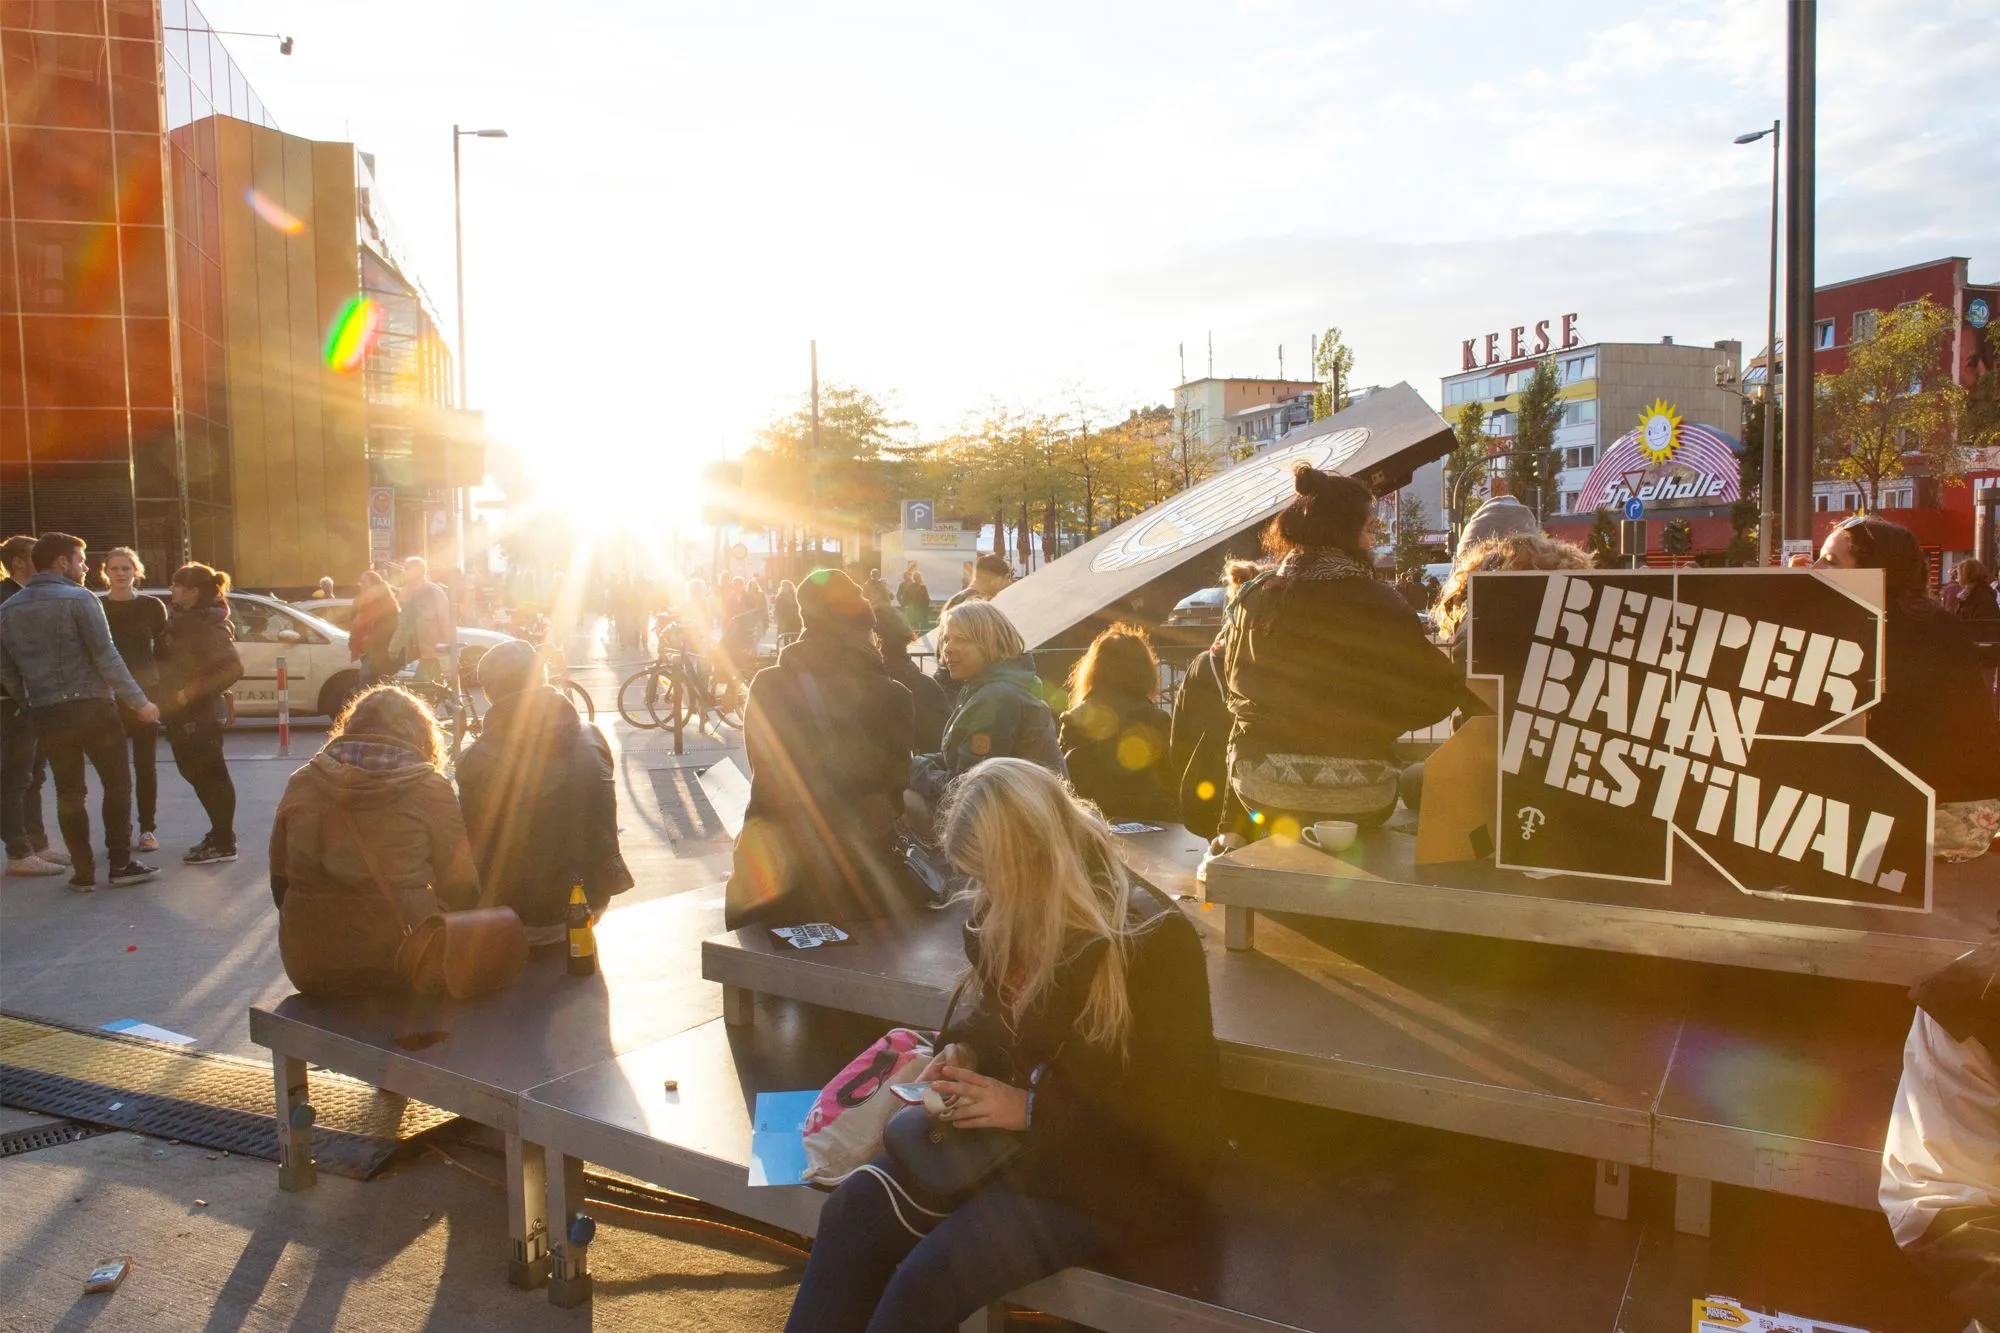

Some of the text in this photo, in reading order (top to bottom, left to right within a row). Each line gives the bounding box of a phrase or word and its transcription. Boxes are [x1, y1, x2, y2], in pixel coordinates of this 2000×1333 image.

[1462, 313, 1578, 371] KEESE
[1598, 472, 1727, 508] Spelhalle
[372, 516, 391, 527] TAXI
[1535, 576, 1864, 714] REEPER
[236, 691, 274, 700] TAXI
[1516, 642, 1764, 766] BAHN
